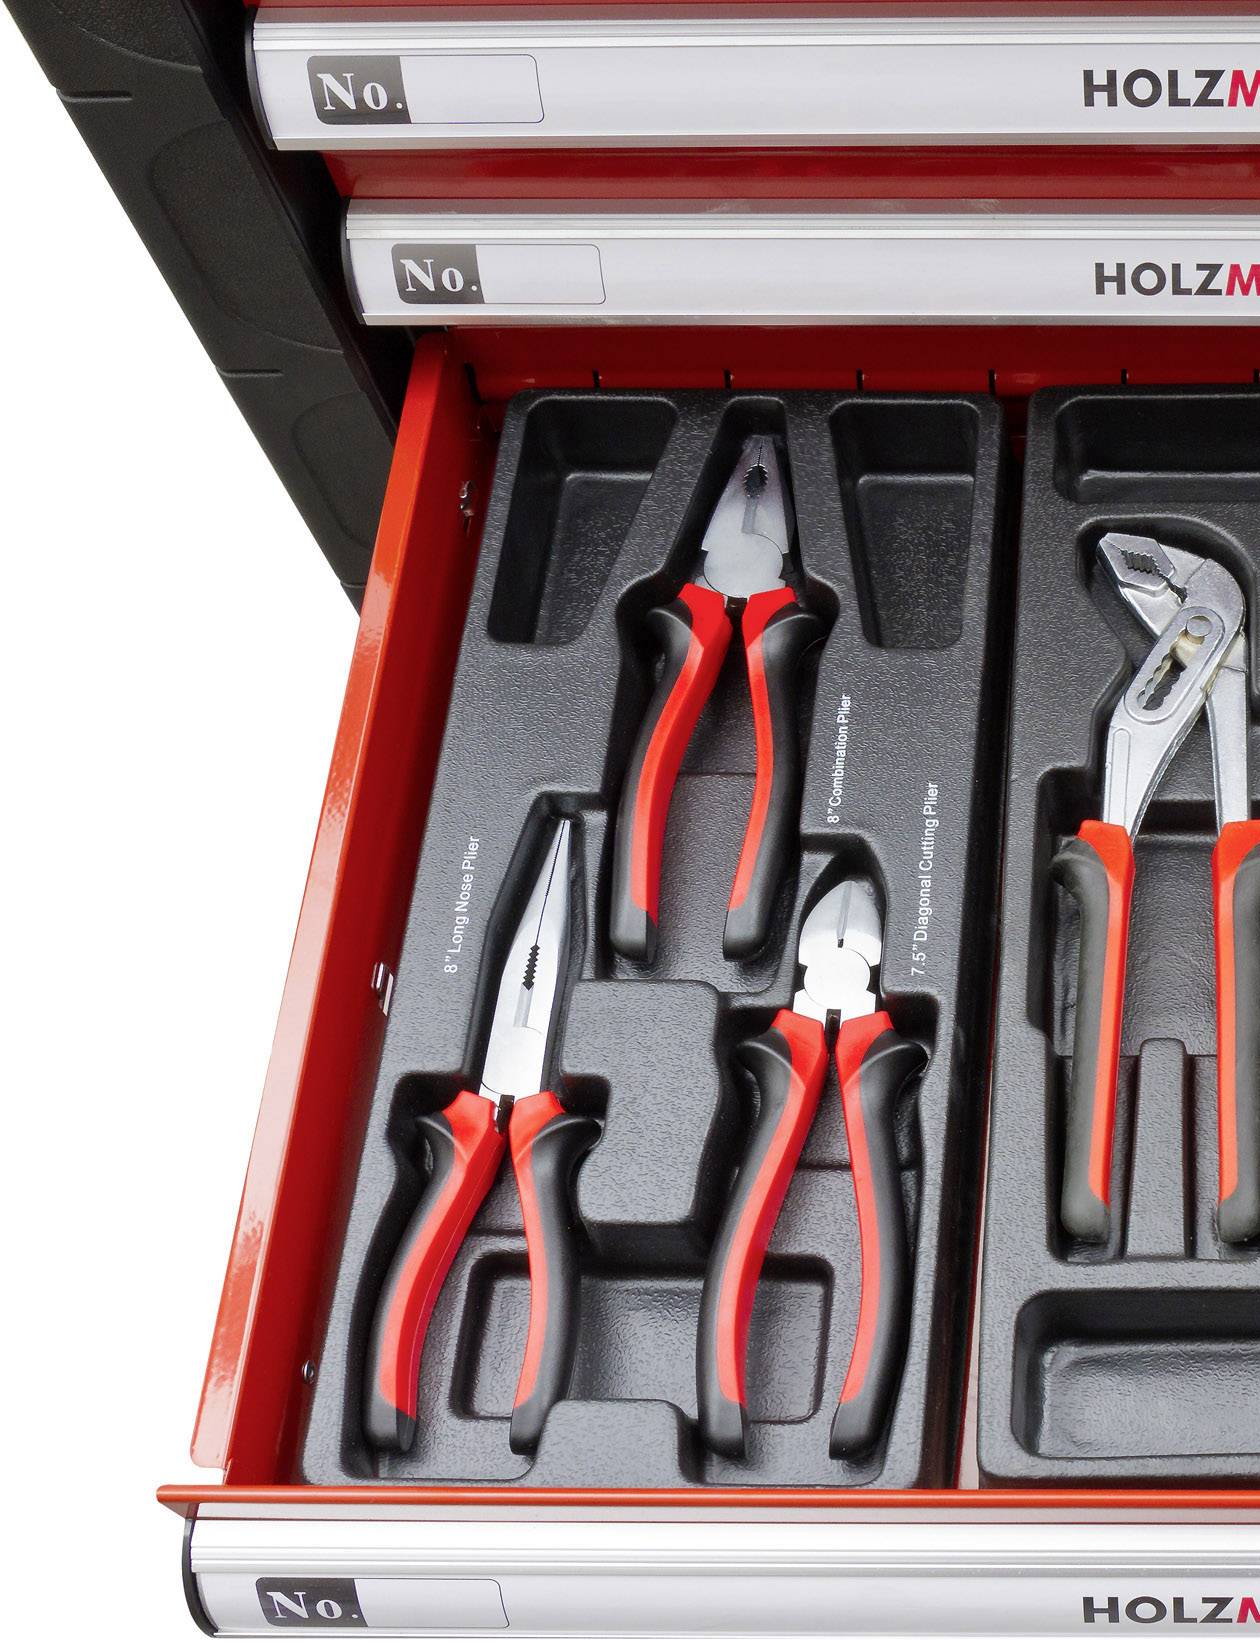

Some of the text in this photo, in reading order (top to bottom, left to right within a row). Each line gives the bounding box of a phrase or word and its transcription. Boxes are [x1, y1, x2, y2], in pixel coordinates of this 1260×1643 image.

[317, 72, 404, 111] No.
[400, 258, 479, 293] No.
[837, 694, 851, 723] Plier
[829, 726, 848, 807] Combination
[923, 782, 940, 815] Plier
[462, 836, 480, 870] Plier
[919, 819, 939, 871] Cutting
[454, 874, 473, 912] Nose
[913, 875, 932, 941] Diagonal
[447, 916, 469, 953] Long
[267, 1591, 358, 1620] No.
